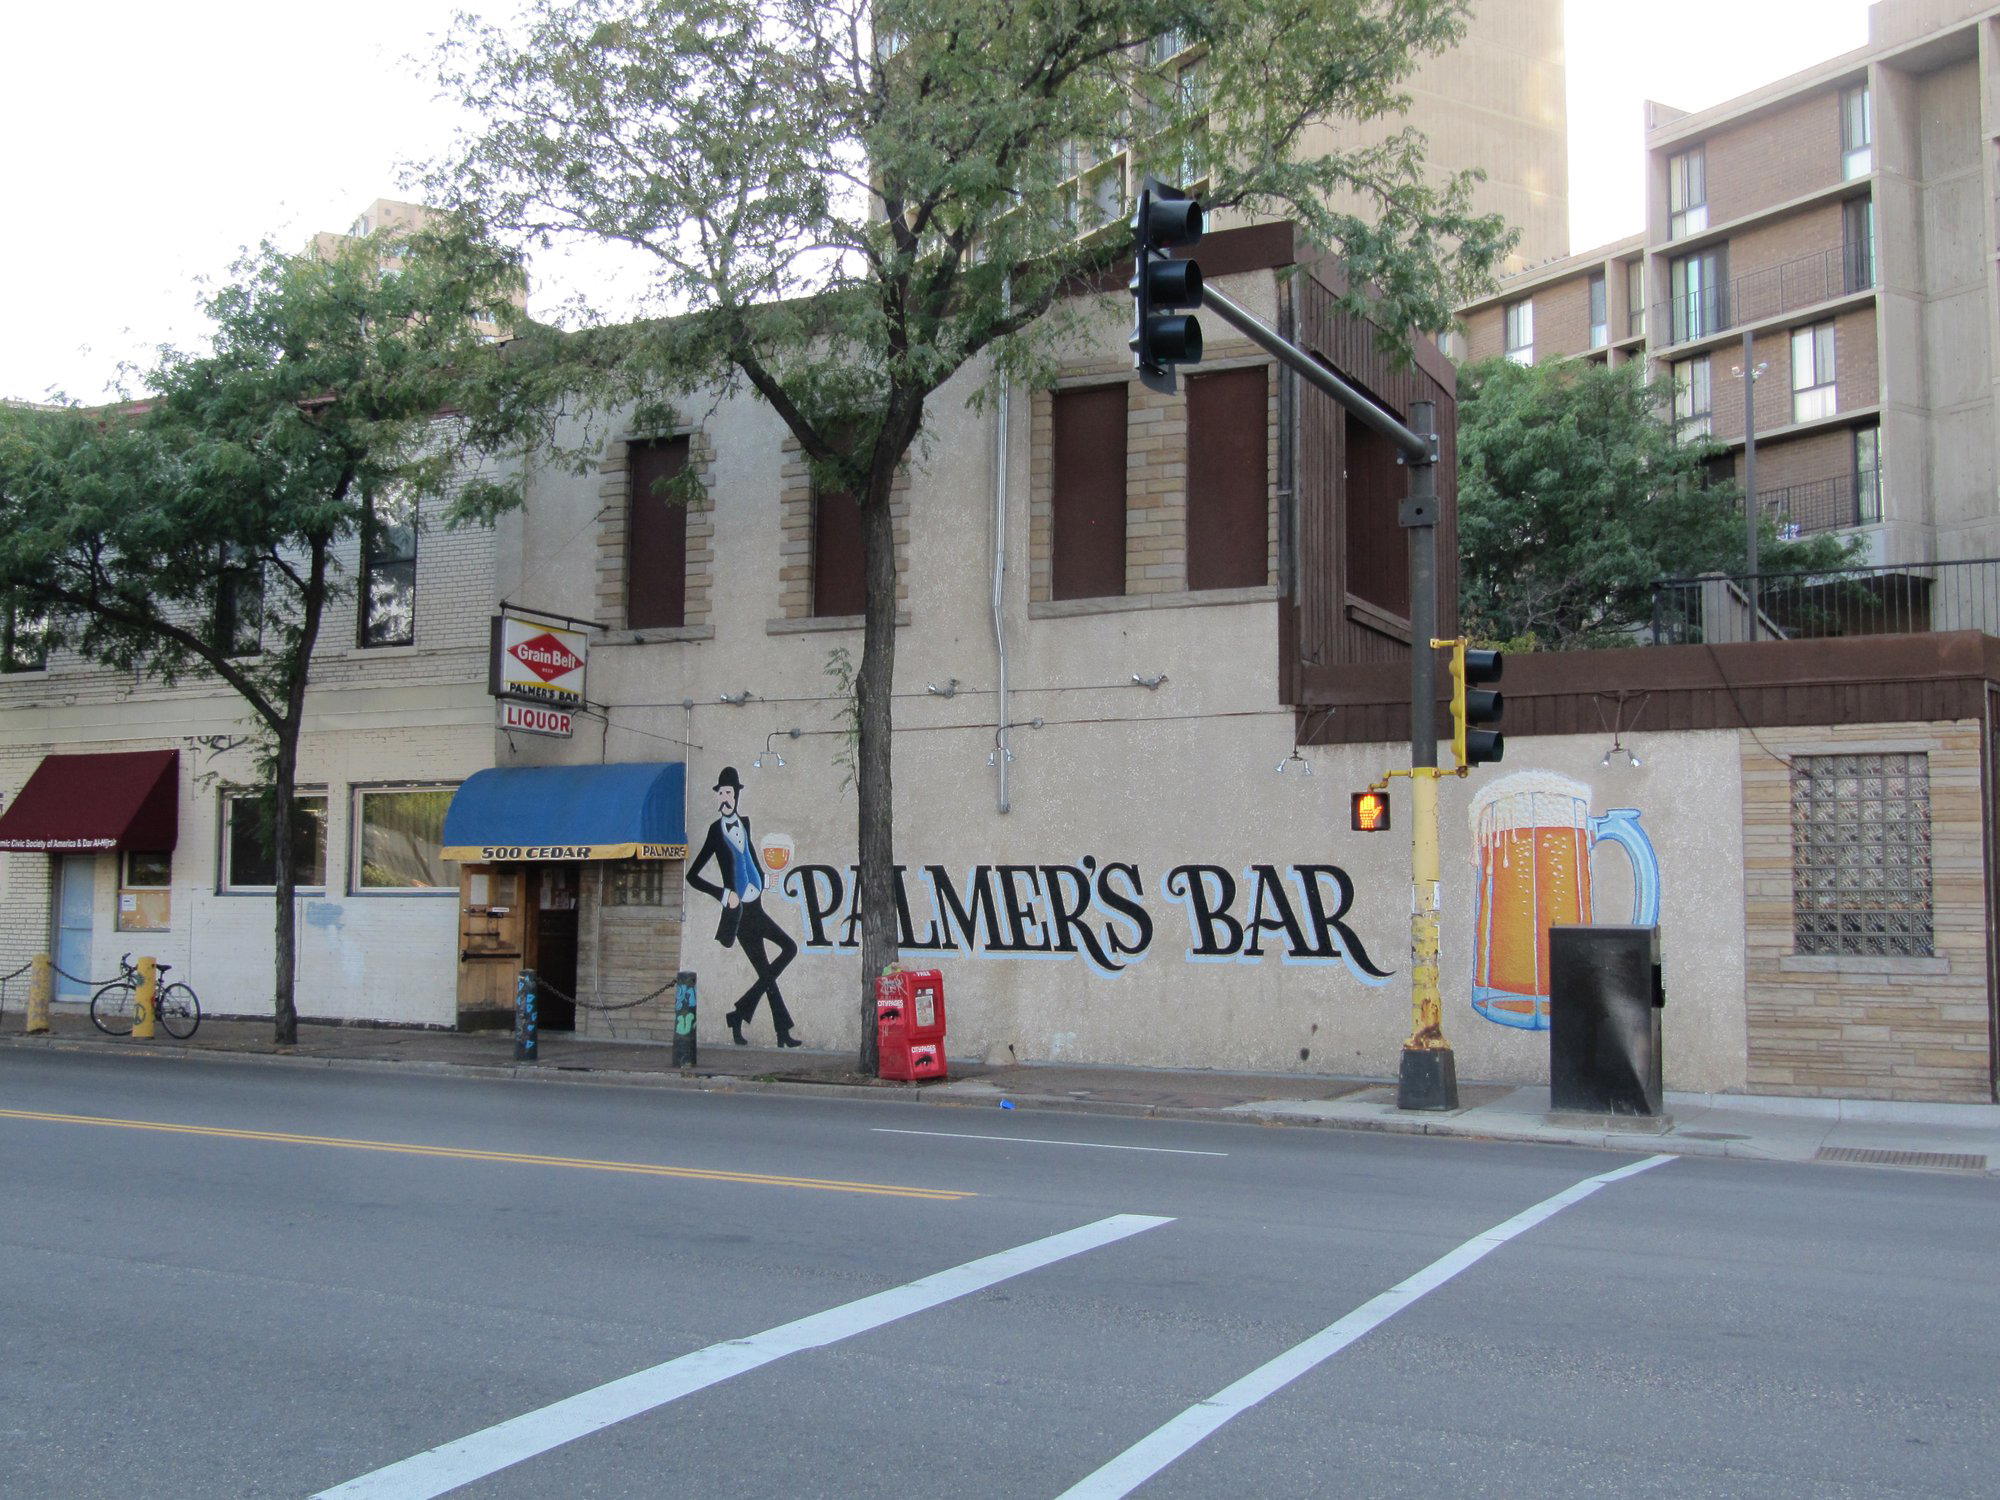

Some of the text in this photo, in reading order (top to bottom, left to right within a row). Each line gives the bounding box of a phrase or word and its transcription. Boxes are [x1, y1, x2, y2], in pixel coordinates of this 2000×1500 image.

[518, 644, 576, 668] Grain Belt
[510, 683, 579, 702] PALMER'S BAR
[507, 707, 570, 732] LIQUOR
[11, 840, 26, 848] Civic
[26, 840, 46, 849] Society
[54, 840, 76, 848] America
[77, 839, 83, 847] &
[83, 839, 93, 847] Dar
[481, 847, 592, 859] 500 CEDAR
[642, 846, 686, 858] PALMERS
[1167, 863, 1397, 977] BAR
